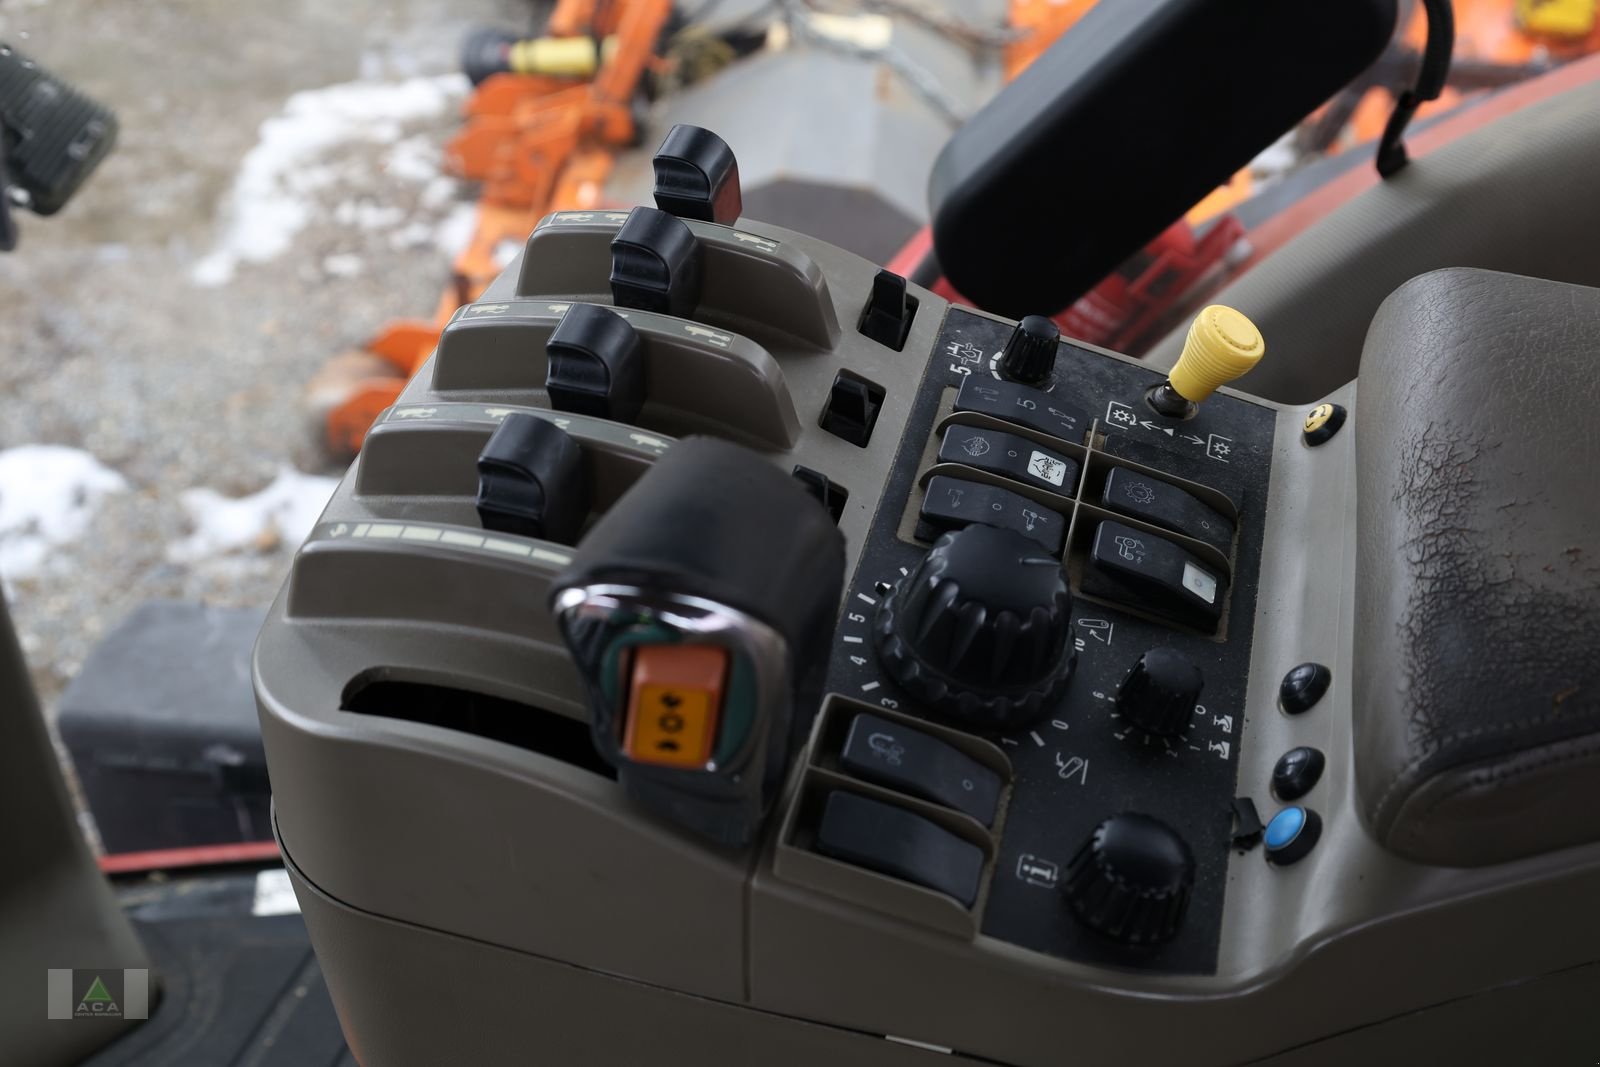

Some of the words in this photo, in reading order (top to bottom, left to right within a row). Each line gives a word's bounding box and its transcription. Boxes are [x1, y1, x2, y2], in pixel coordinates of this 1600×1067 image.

[848, 612, 866, 623] 5
[850, 655, 867, 666] 4
[880, 697, 899, 709] 3
